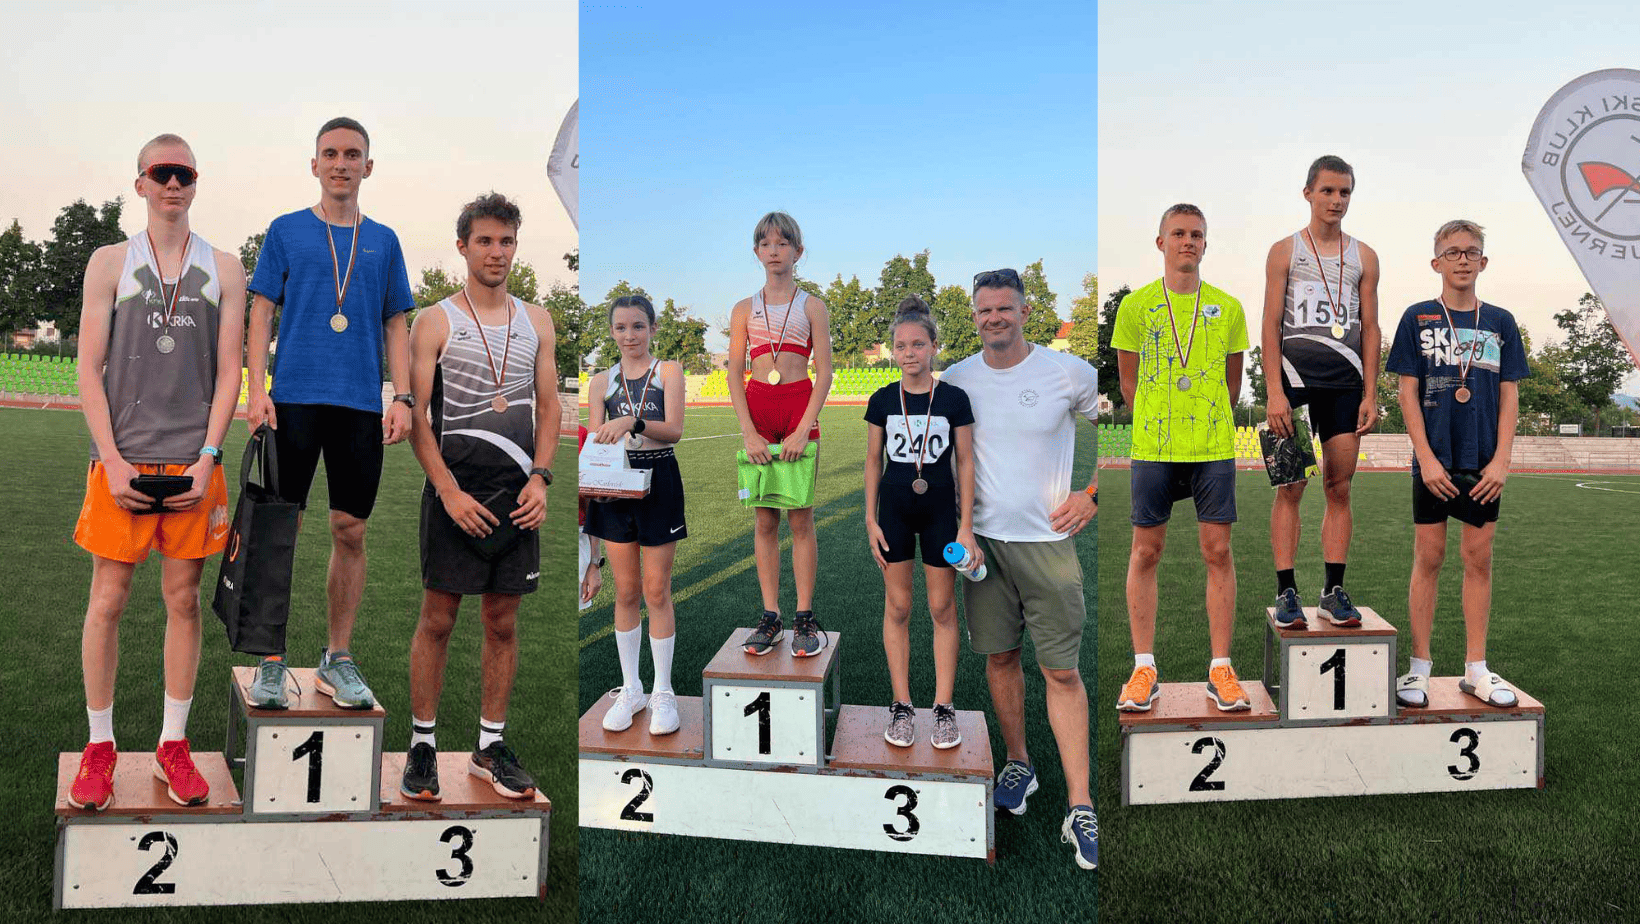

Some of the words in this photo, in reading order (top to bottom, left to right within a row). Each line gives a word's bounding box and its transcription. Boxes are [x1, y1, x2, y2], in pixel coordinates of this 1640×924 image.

[1297, 299, 1348, 326] 159
[892, 433, 943, 459] 240
[1320, 648, 1346, 710] 1
[743, 691, 771, 755] 1
[292, 731, 324, 803] 1
[1188, 736, 1227, 792] 2
[1447, 727, 1481, 781] 3
[619, 768, 654, 823] 2
[882, 784, 920, 842] 3
[132, 830, 179, 895] 2
[435, 825, 475, 888] 3
